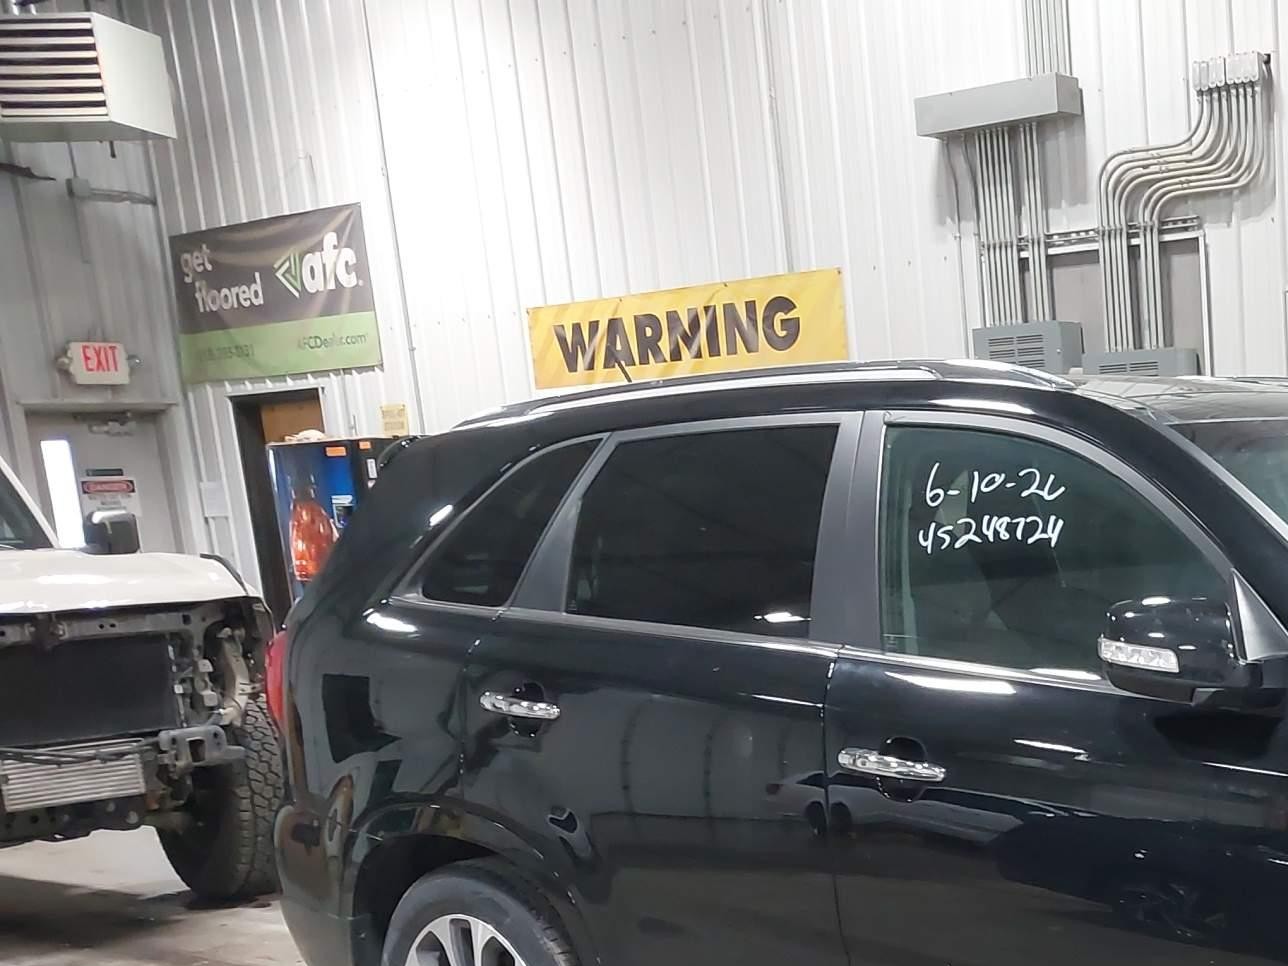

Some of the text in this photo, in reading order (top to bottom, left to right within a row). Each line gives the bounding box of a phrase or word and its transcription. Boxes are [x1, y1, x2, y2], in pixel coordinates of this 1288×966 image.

[180, 244, 212, 283] get
[195, 272, 264, 313] floored
[553, 296, 800, 373] WARNING
[81, 345, 118, 372] EXIT
[918, 515, 1064, 554] 45248724
